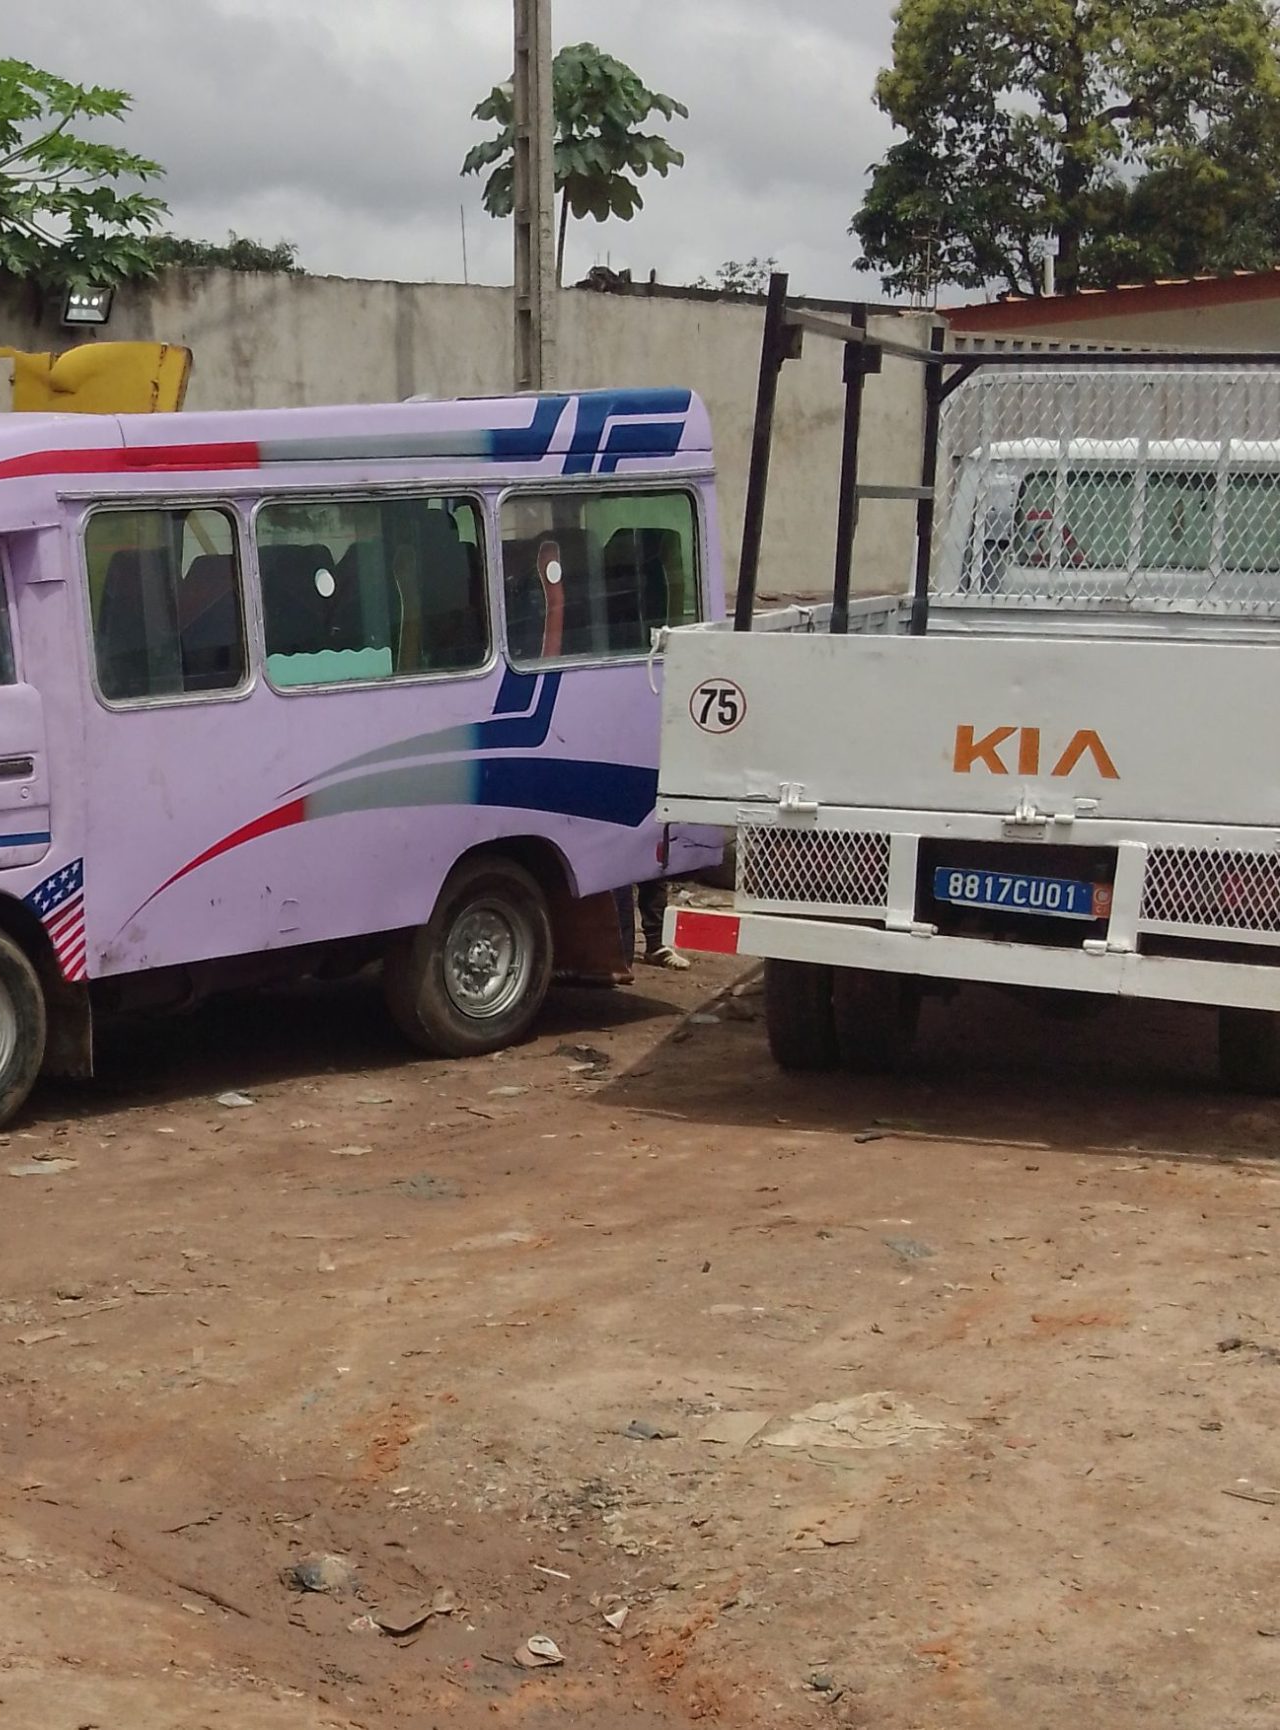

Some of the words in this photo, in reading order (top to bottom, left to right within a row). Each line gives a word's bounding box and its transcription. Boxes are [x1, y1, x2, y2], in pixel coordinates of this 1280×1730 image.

[700, 688, 737, 726] 75
[953, 725, 1121, 780] KIA
[948, 872, 1075, 911] 8817CU01
